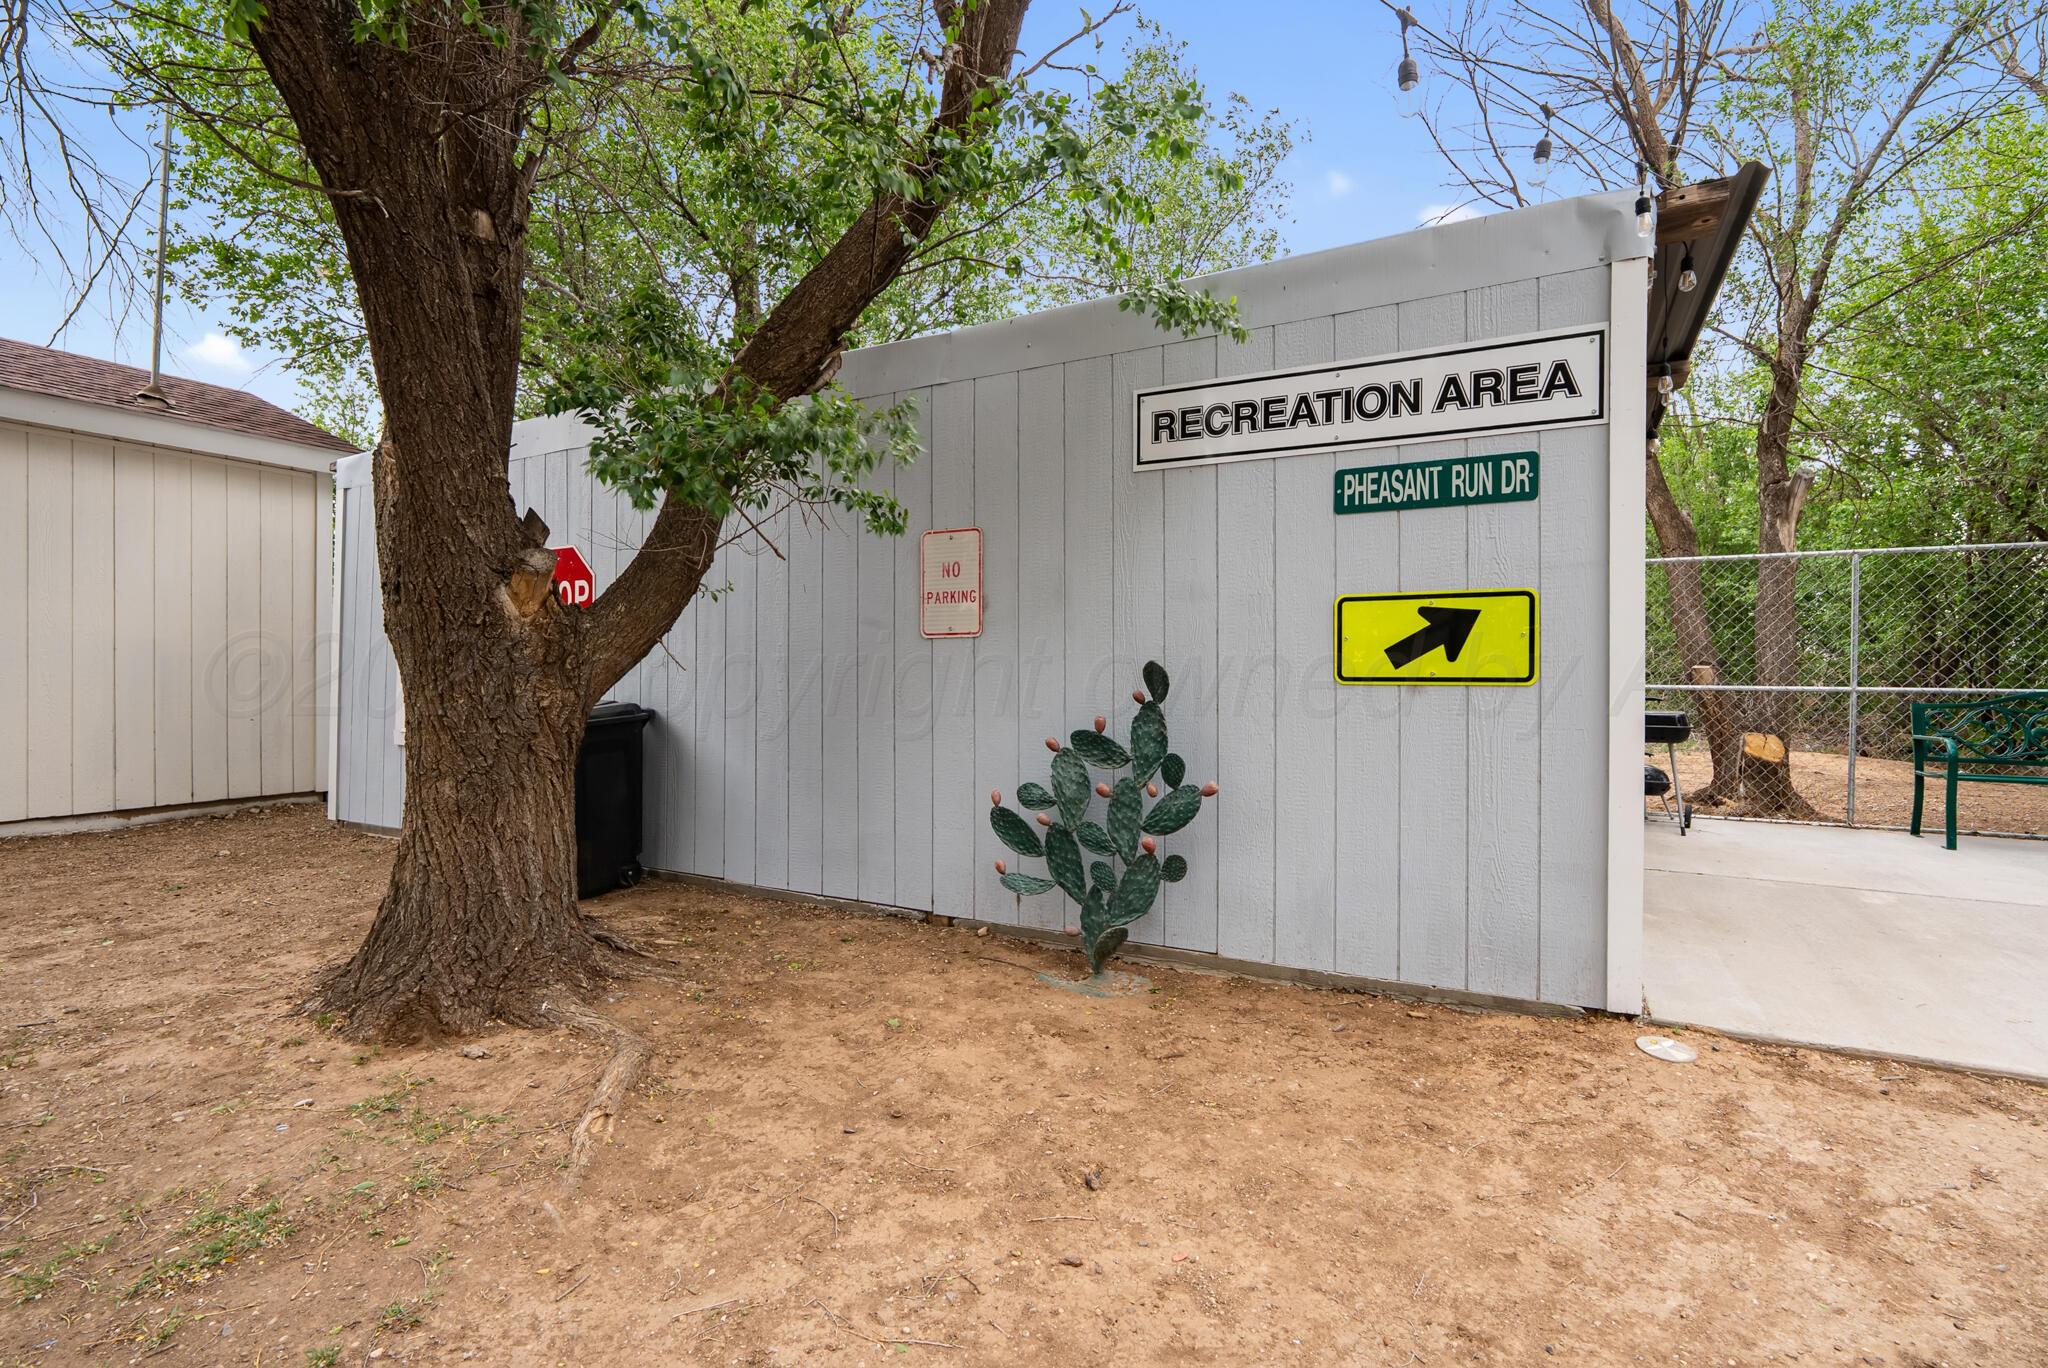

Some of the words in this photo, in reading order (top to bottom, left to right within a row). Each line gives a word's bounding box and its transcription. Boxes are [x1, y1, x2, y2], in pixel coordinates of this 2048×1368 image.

[1151, 377, 1423, 444] RECREATION
[1432, 359, 1583, 414] AREA
[1342, 466, 1443, 506] PHEASANT
[1451, 460, 1493, 498] RUN
[1500, 457, 1530, 494] DR
[942, 561, 961, 578] NO
[559, 579, 590, 606] OP
[926, 589, 977, 605] PARKING
